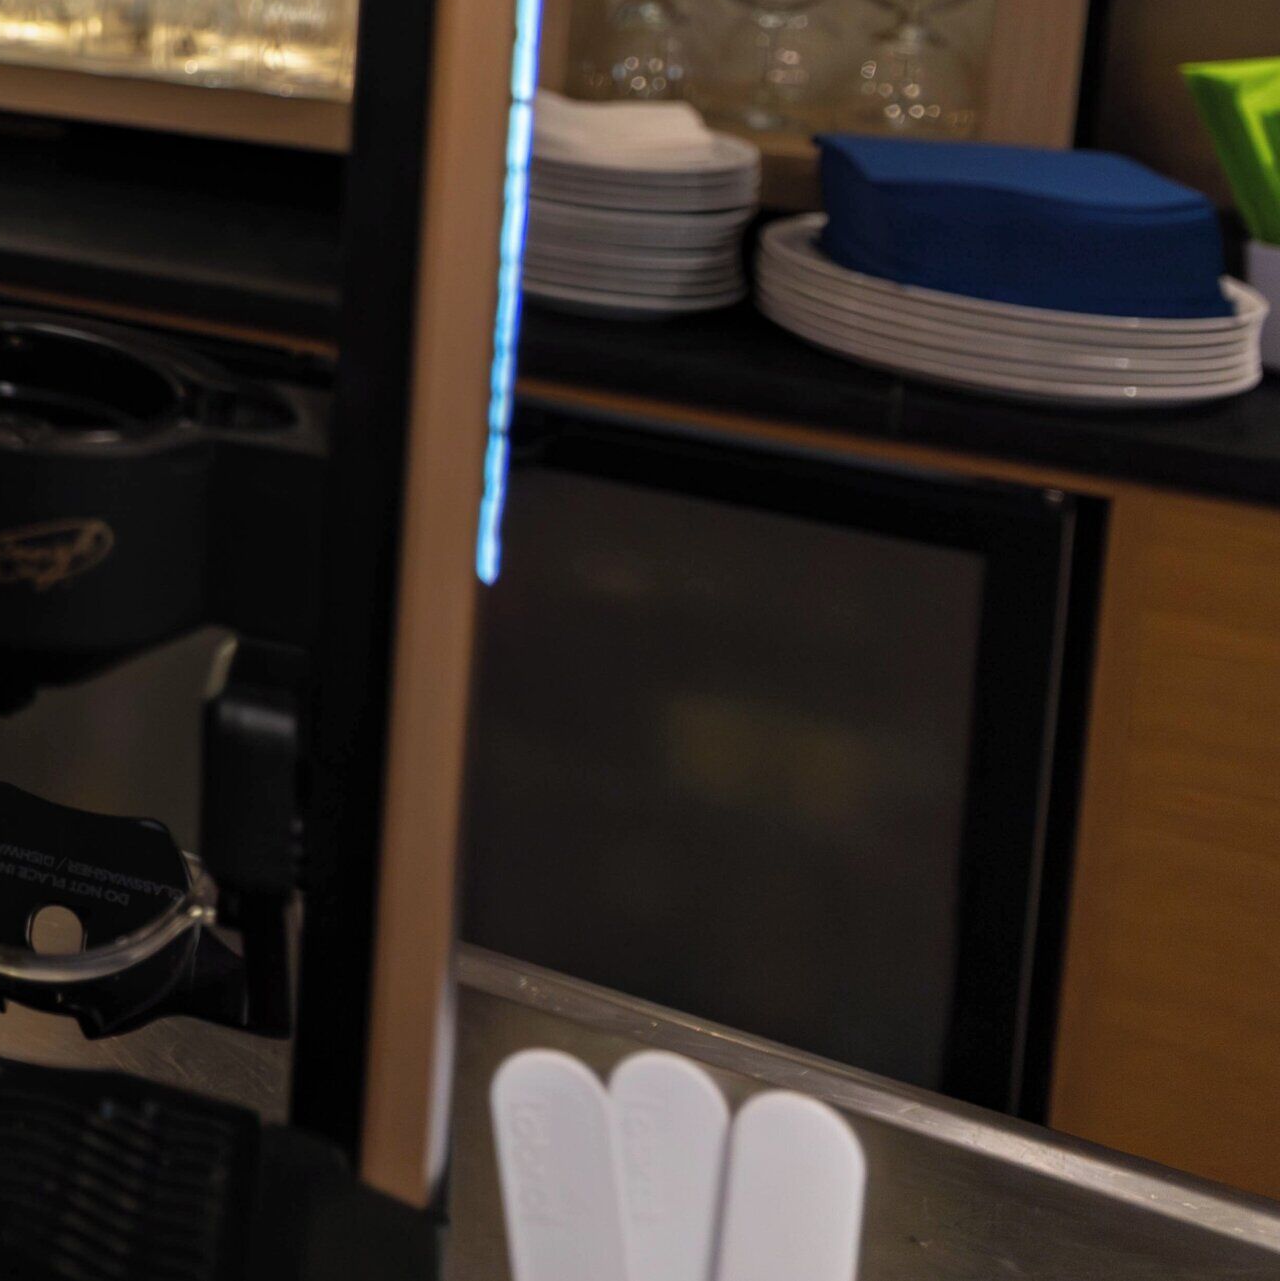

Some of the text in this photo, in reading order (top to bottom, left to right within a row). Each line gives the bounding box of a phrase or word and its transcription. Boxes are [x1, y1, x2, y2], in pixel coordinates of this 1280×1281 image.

[17, 866, 67, 890] PLACE
[67, 860, 186, 901] GLASSWASHER
[70, 878, 103, 899] NOT
[105, 888, 130, 907] DO
